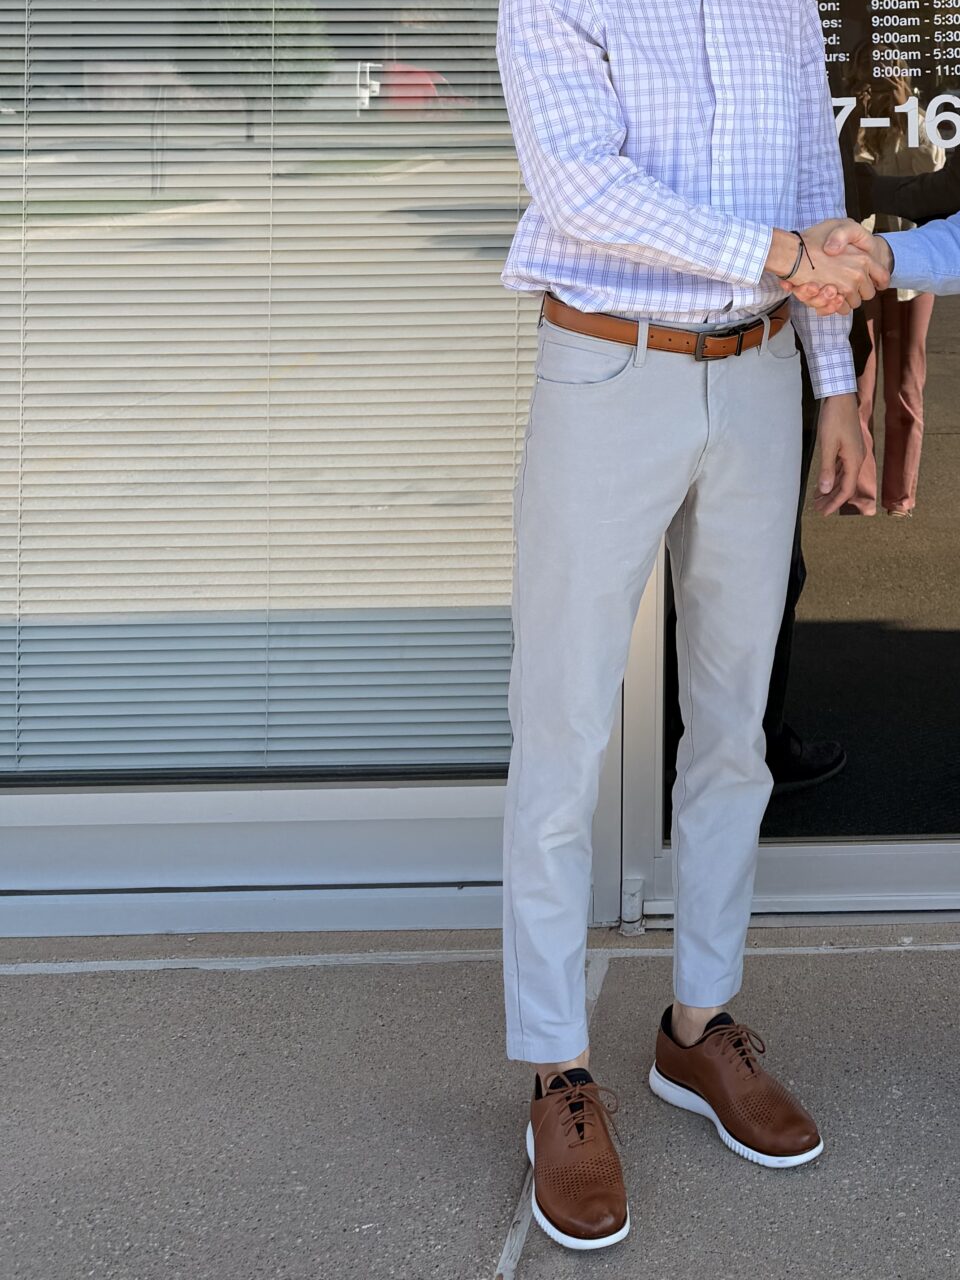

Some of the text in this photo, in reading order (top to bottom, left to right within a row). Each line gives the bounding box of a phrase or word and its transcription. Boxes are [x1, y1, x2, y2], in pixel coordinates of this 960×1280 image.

[871, 15, 920, 27] 9:00am
[872, 32, 921, 44] 9:00am
[872, 49, 921, 61] 9:00am
[873, 66, 921, 77] 8:00am
